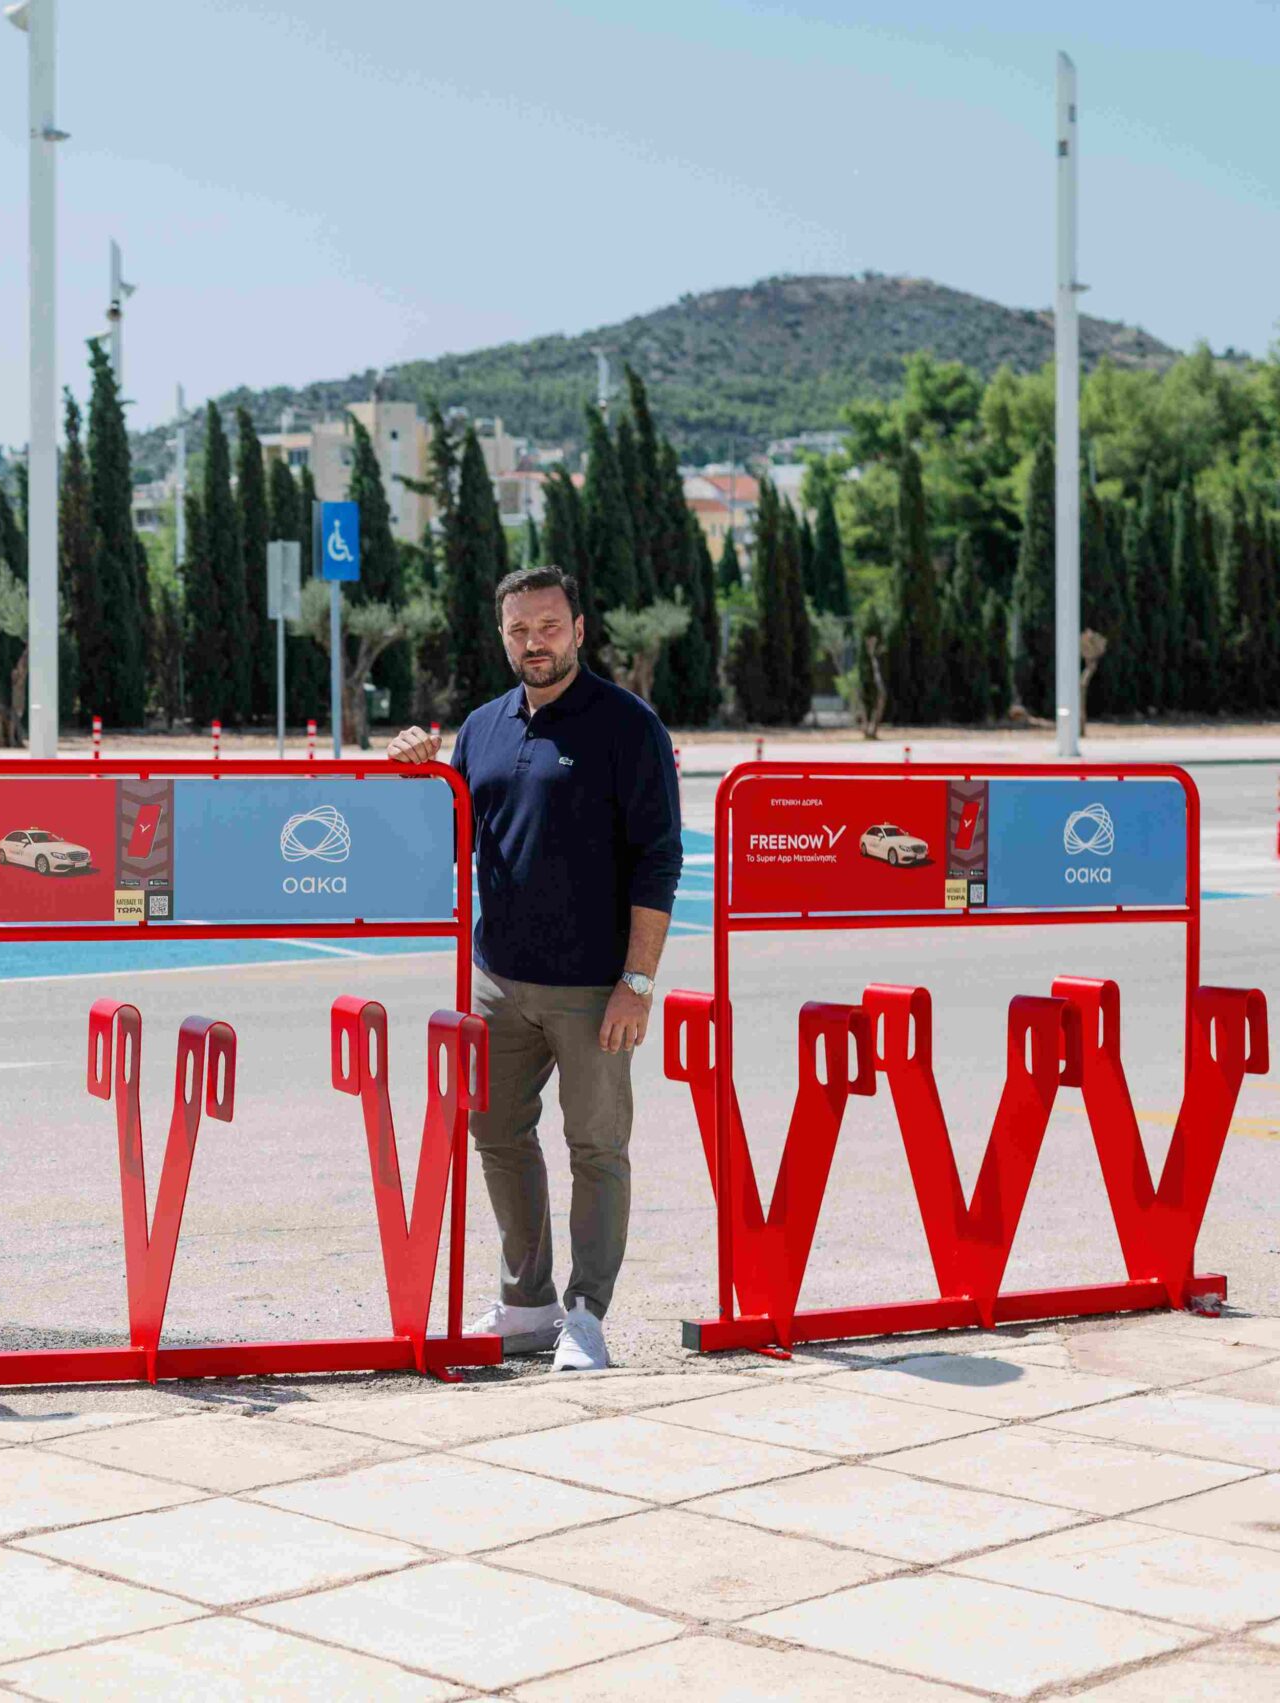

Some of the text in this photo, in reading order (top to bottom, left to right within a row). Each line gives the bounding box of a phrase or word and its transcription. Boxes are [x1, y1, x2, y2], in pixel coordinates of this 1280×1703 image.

[750, 834, 824, 850] FREENOW
[756, 853, 777, 864] Super
[777, 854, 793, 864] App
